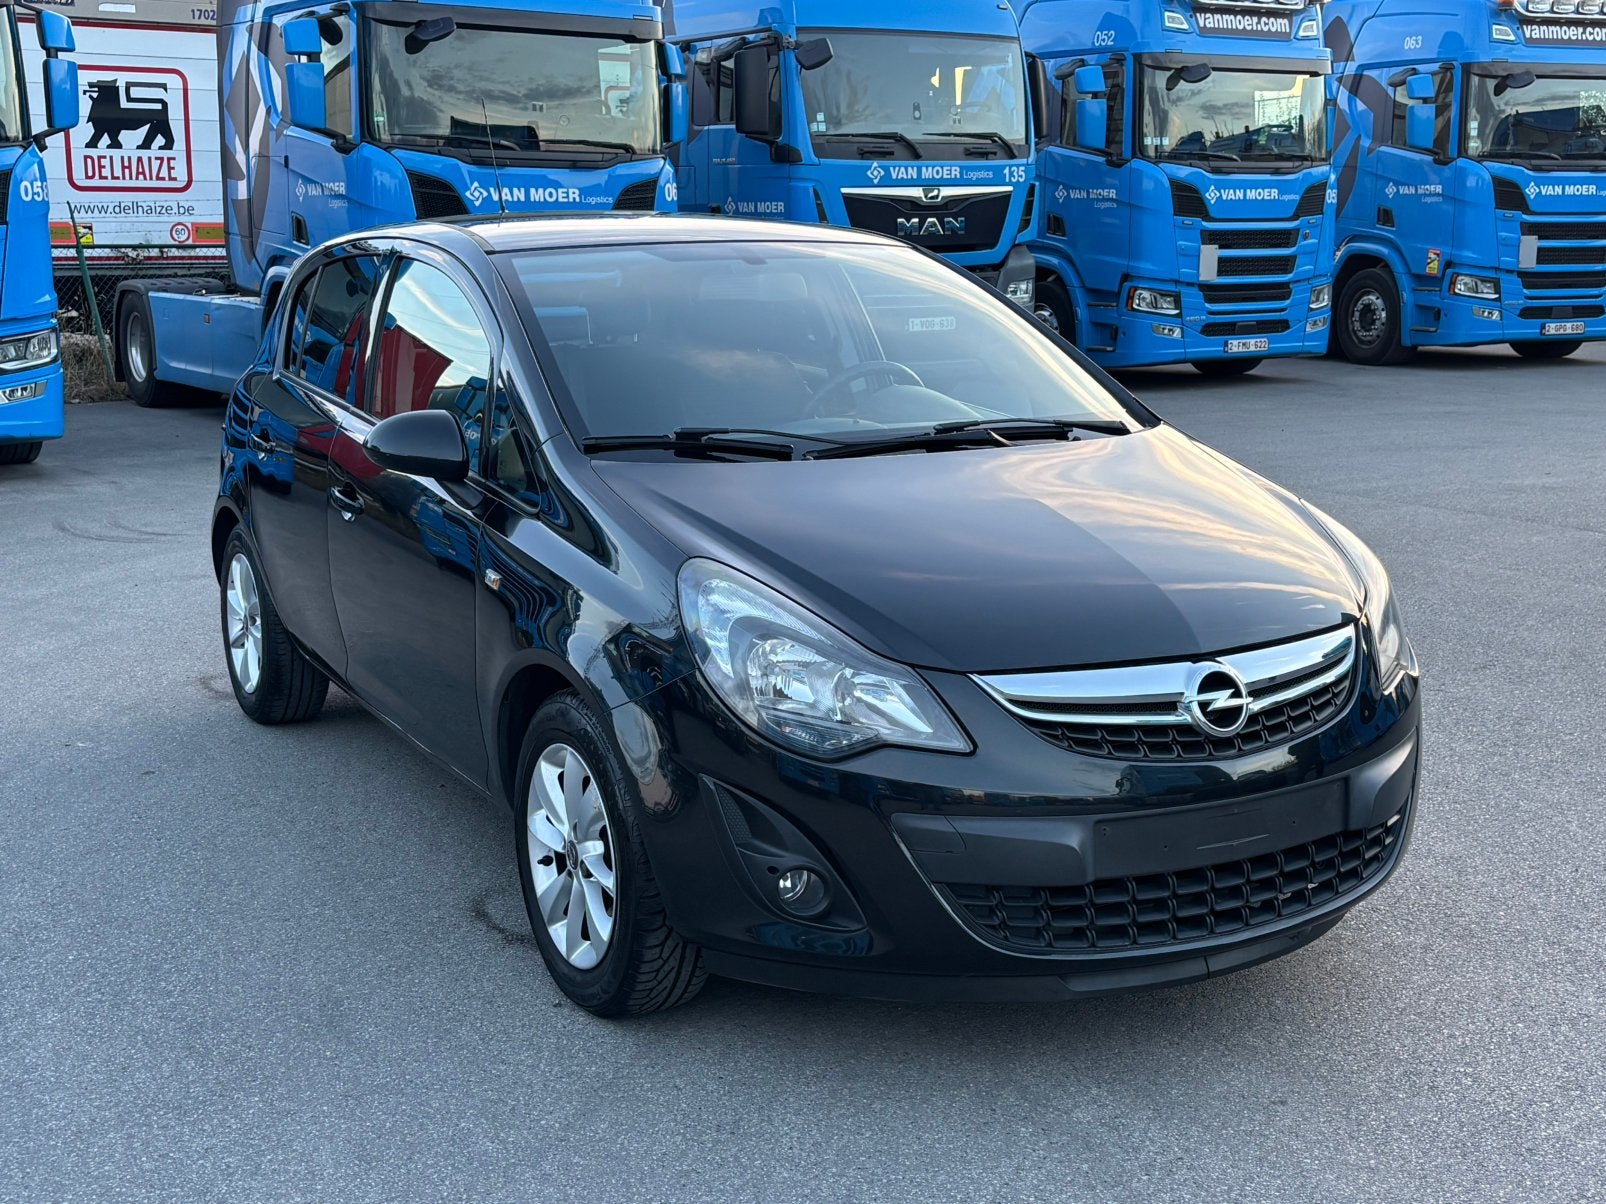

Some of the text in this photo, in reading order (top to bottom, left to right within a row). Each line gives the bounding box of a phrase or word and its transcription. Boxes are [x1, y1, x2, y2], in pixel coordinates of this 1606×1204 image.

[191, 9, 217, 20] 1702
[1196, 12, 1290, 33] vanmoer.com
[1095, 30, 1115, 46] 052
[1404, 35, 1422, 50] 063
[83, 154, 177, 181] DELHAIZE
[890, 166, 993, 180] VAN MOER Logistics
[1003, 166, 1025, 182] 135
[307, 182, 346, 196] VAN MOER
[489, 187, 613, 204] VAN MOER Logistics
[1070, 188, 1117, 199] VAN MOER
[1221, 188, 1244, 200] VAN
[1246, 188, 1279, 200] MOER
[1399, 184, 1443, 195] VAN MOER
[1540, 184, 1563, 196] VAN
[1564, 184, 1597, 196] MOER
[71, 201, 195, 216] www.delhaize.be
[738, 201, 785, 213] VAN MOER
[897, 217, 966, 236] MAN
